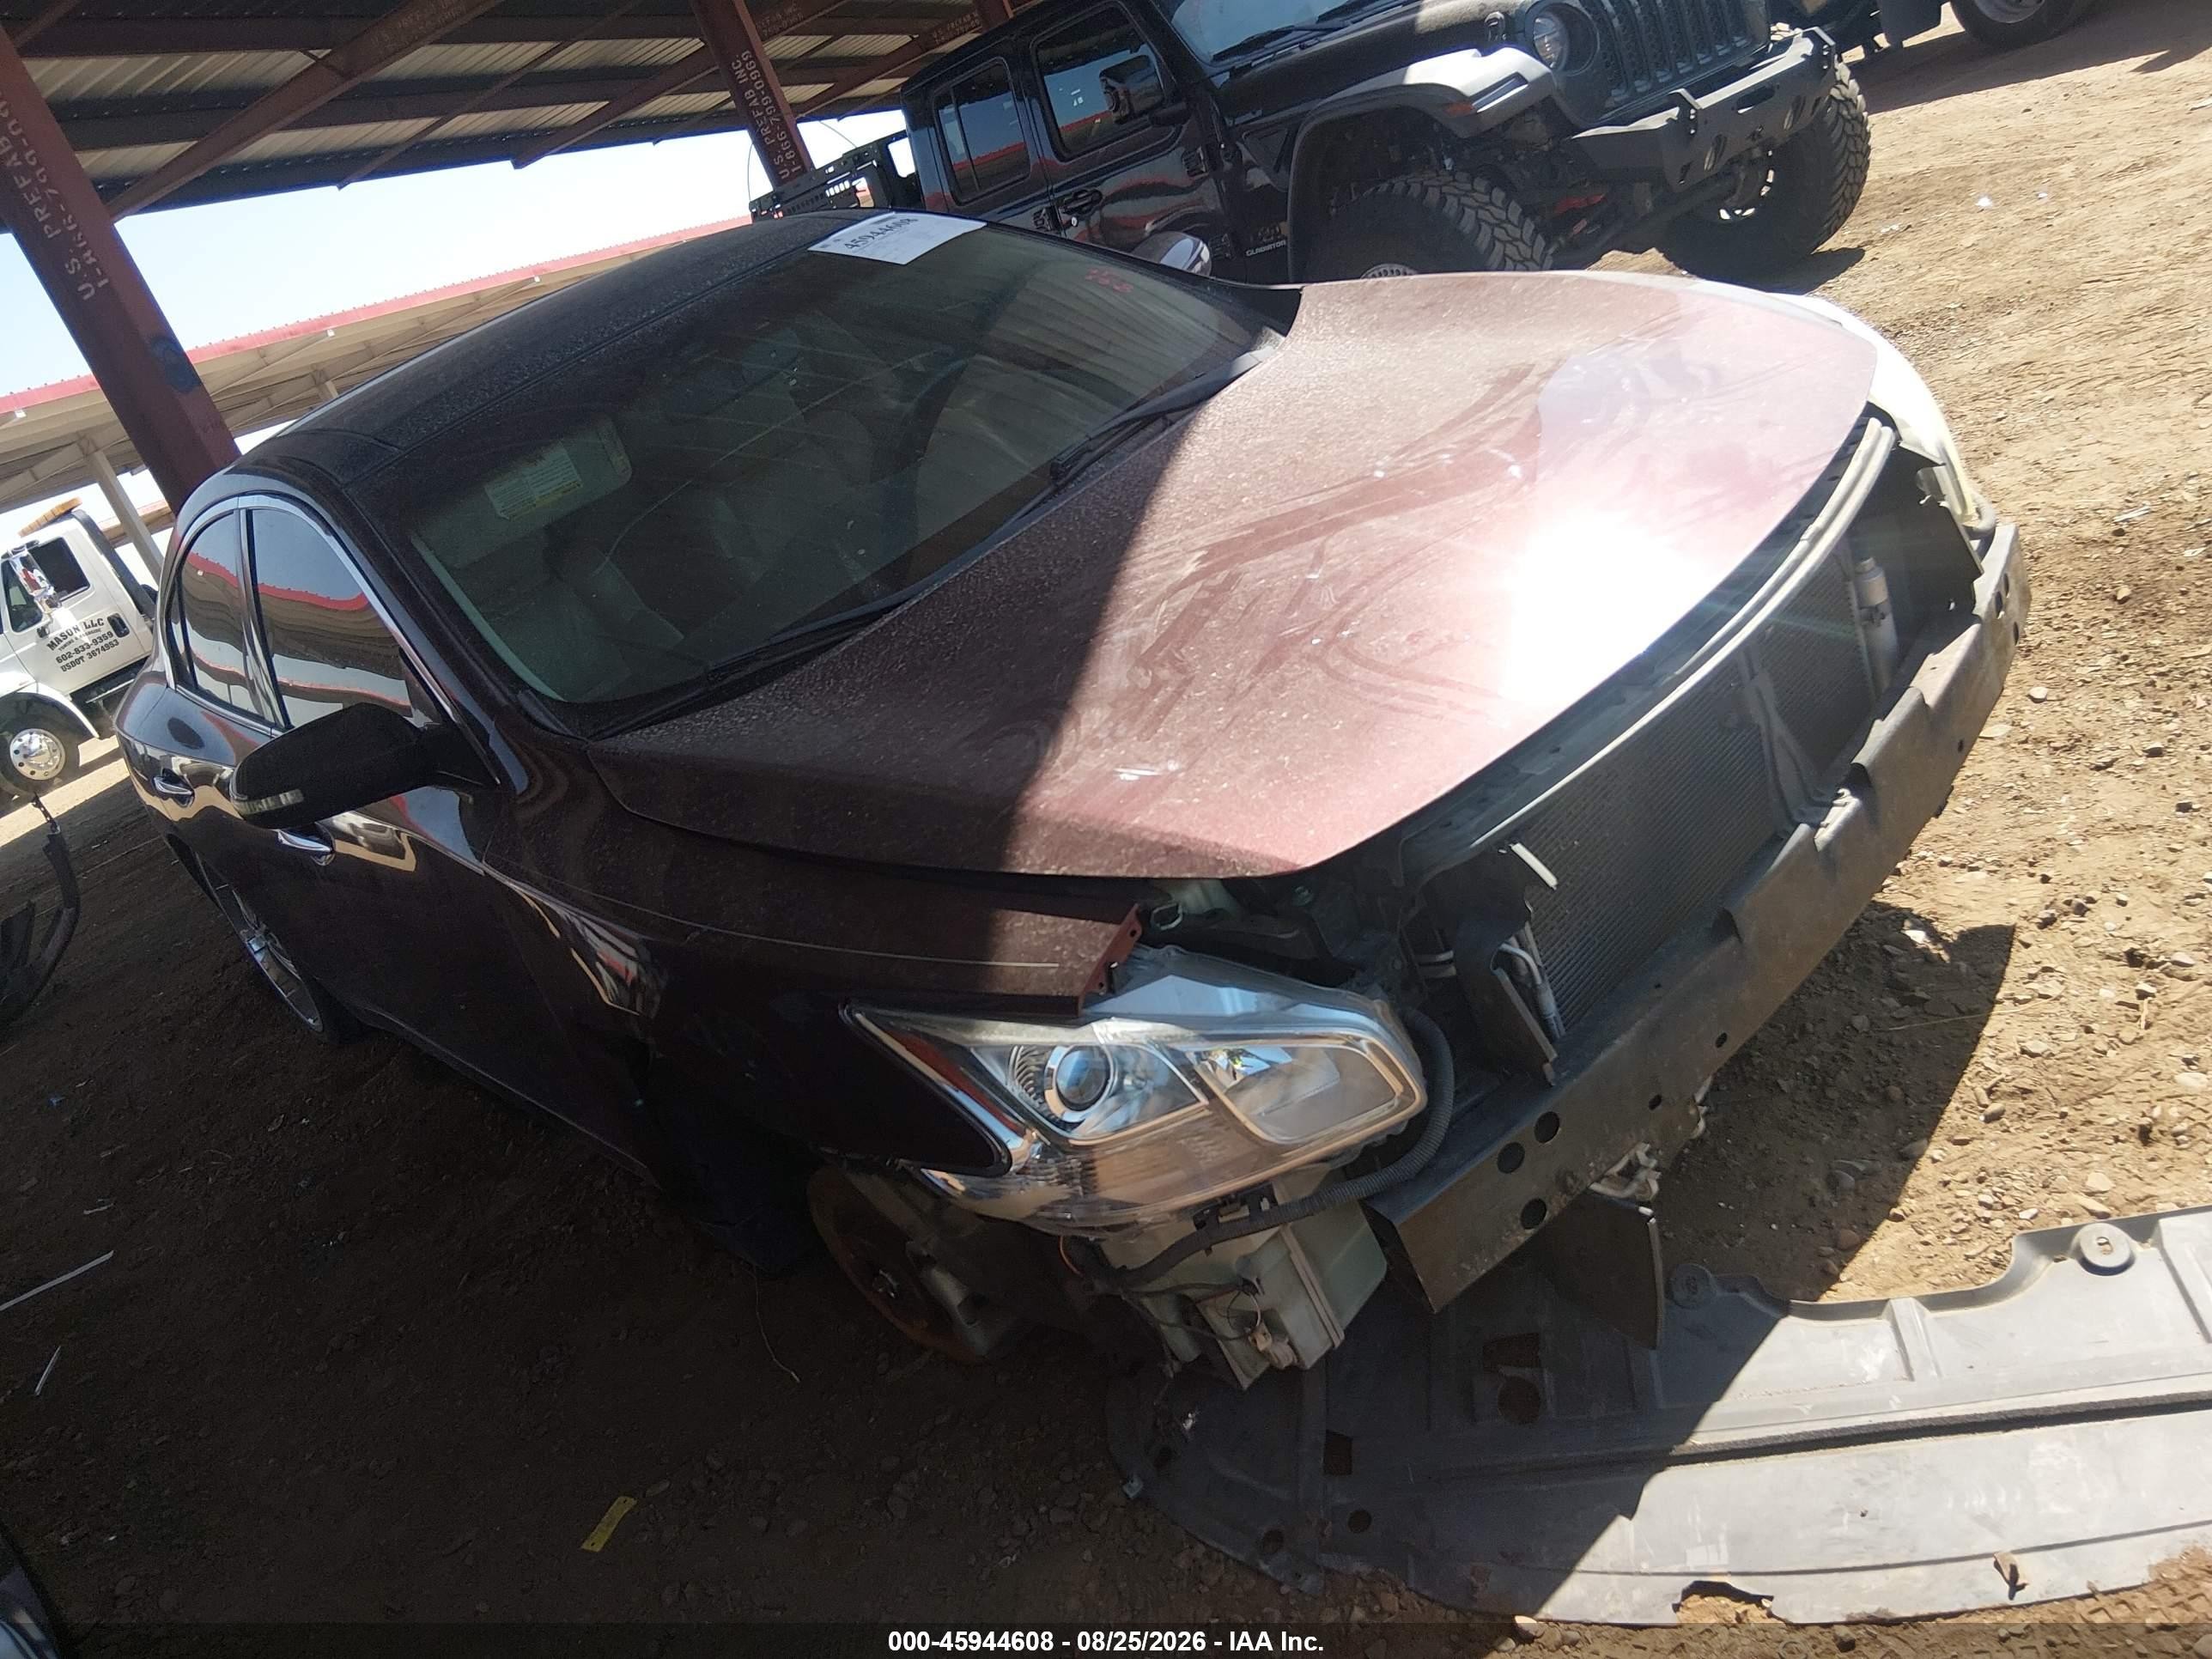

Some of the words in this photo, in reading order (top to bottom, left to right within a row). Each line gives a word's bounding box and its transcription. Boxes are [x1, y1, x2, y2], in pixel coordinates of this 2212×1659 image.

[732, 54, 749, 84] INC.
[741, 50, 801, 173] 1-866-799-0969
[744, 89, 775, 145] PREFAB
[774, 149, 790, 179] U.S.
[0, 136, 62, 239] PREFAB
[1246, 240, 1286, 257] GLADIATOR
[64, 248, 96, 301] U.S.
[46, 624, 81, 651] MASON
[83, 617, 105, 629] LLC
[55, 630, 114, 664] 602-833-9359
[60, 655, 85, 672] USDOT
[86, 639, 119, 659] 3674953
